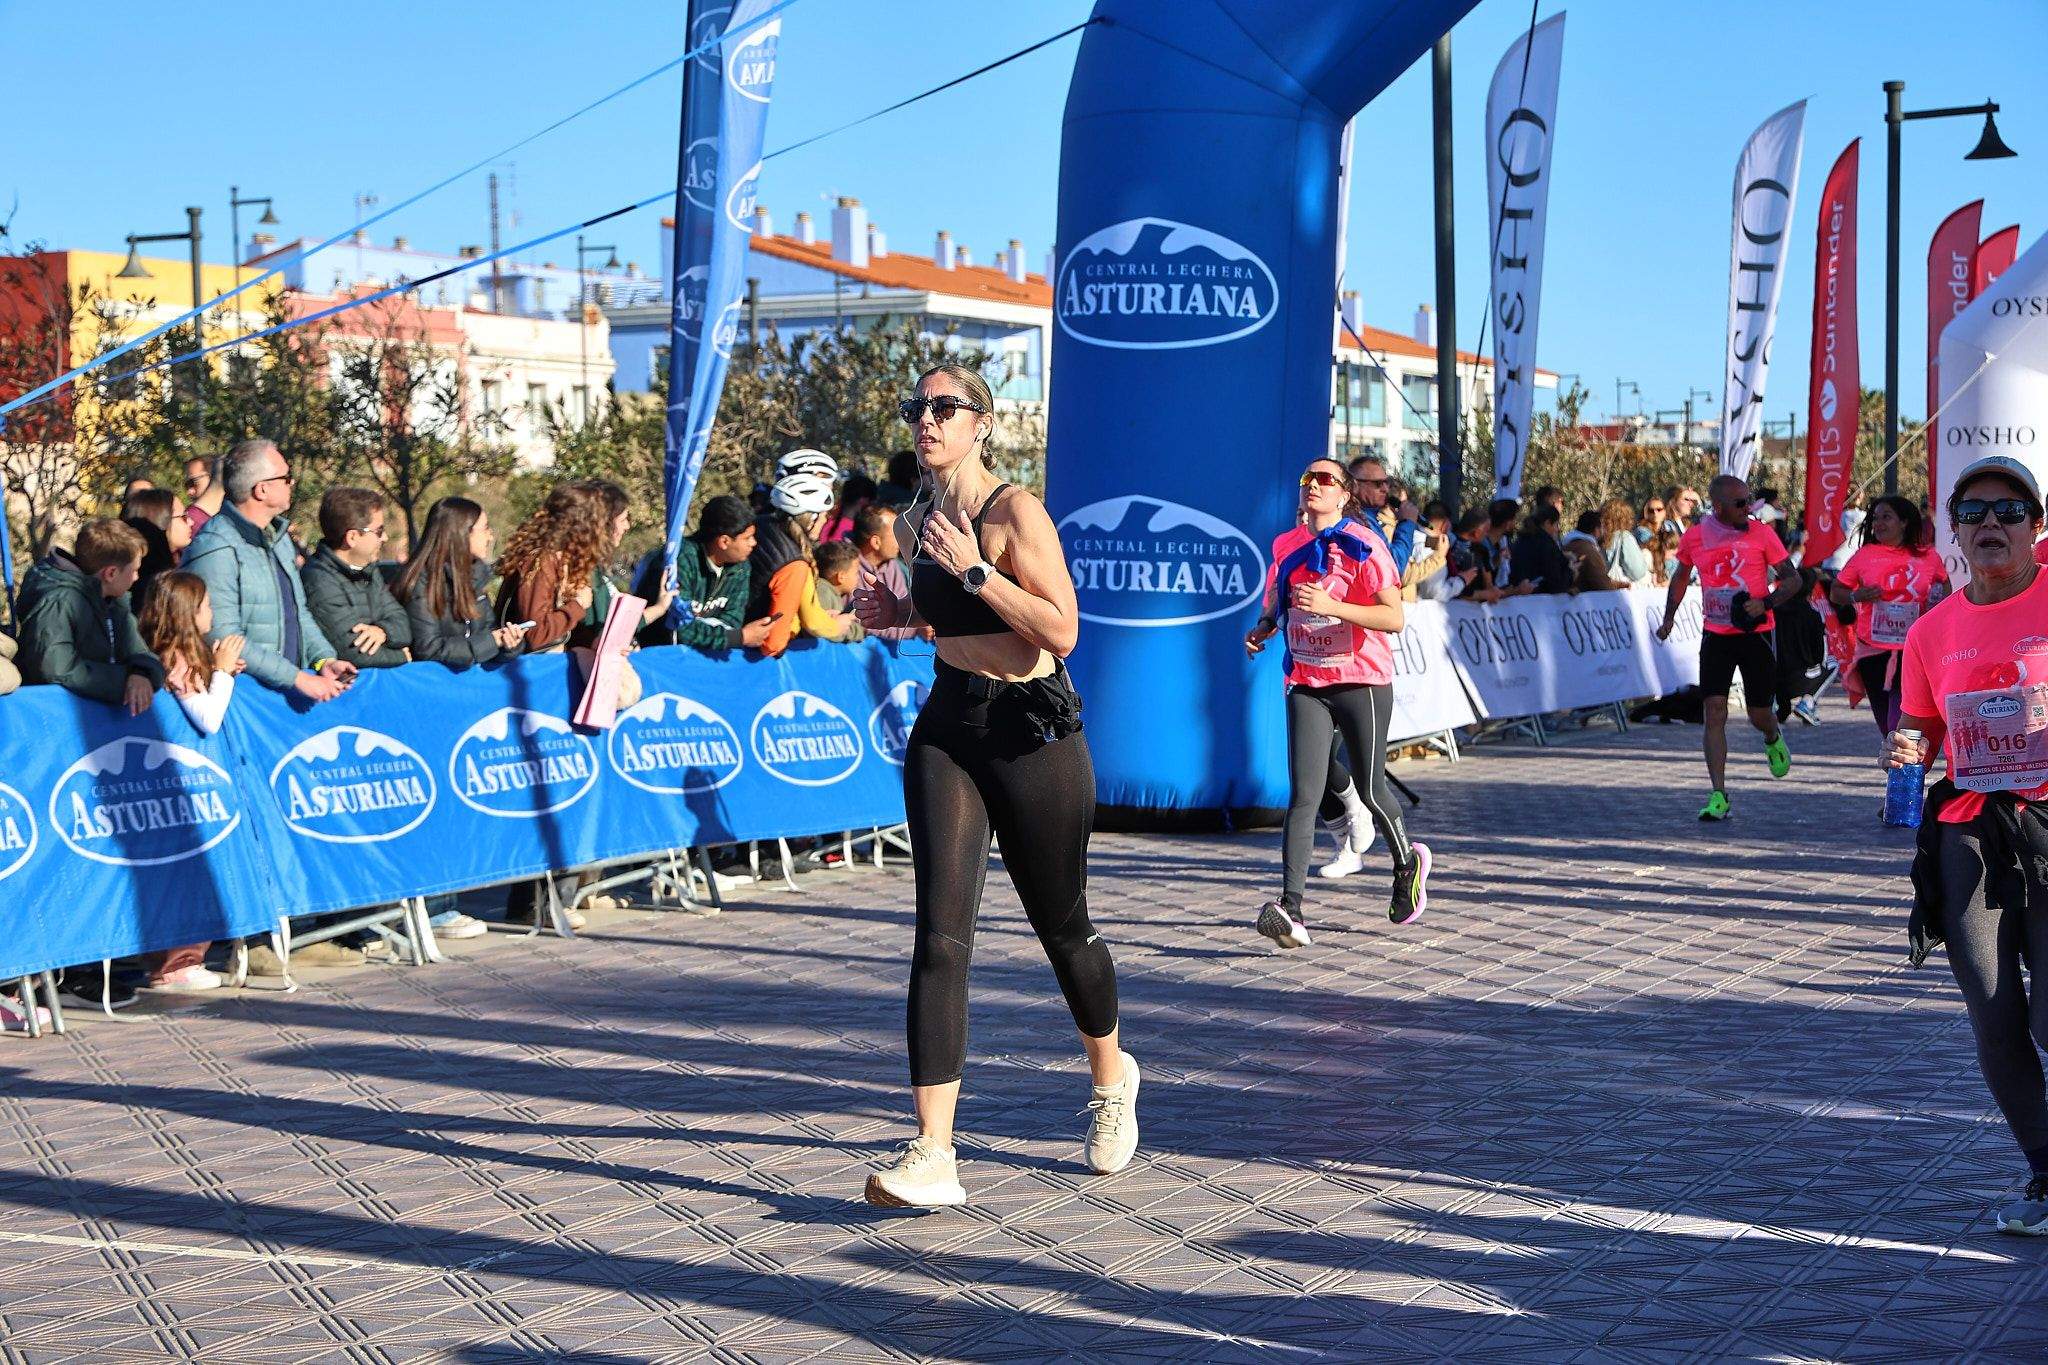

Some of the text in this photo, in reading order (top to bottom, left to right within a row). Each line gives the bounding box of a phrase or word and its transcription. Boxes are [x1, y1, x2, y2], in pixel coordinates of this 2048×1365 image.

[1086, 263, 1254, 280] CENTRAL LECHERA
[1062, 269, 1261, 318] ASTURIANA
[1992, 296, 2048, 318] OYS
[1947, 425, 2035, 447] OYSHO
[1074, 538, 1241, 557] CENTRAL LECHERA
[1070, 557, 1248, 595] STURIANA
[1309, 636, 1332, 646] 016
[1458, 613, 1539, 665] OYSHO
[1562, 605, 1633, 656] OYSHO
[1941, 648, 1977, 666] OYSHO
[2015, 643, 2048, 653] ASTURIAN
[1981, 705, 2019, 715] ASTURIANA
[622, 732, 737, 773] ASTURIANA
[762, 727, 858, 765] ASTURIANA
[1987, 733, 2027, 752] 016
[465, 752, 590, 798] ASTURIANA
[1968, 776, 2002, 787] OYSHO
[288, 773, 428, 821] ASTURIANA
[70, 790, 231, 842] ASTURIANA
